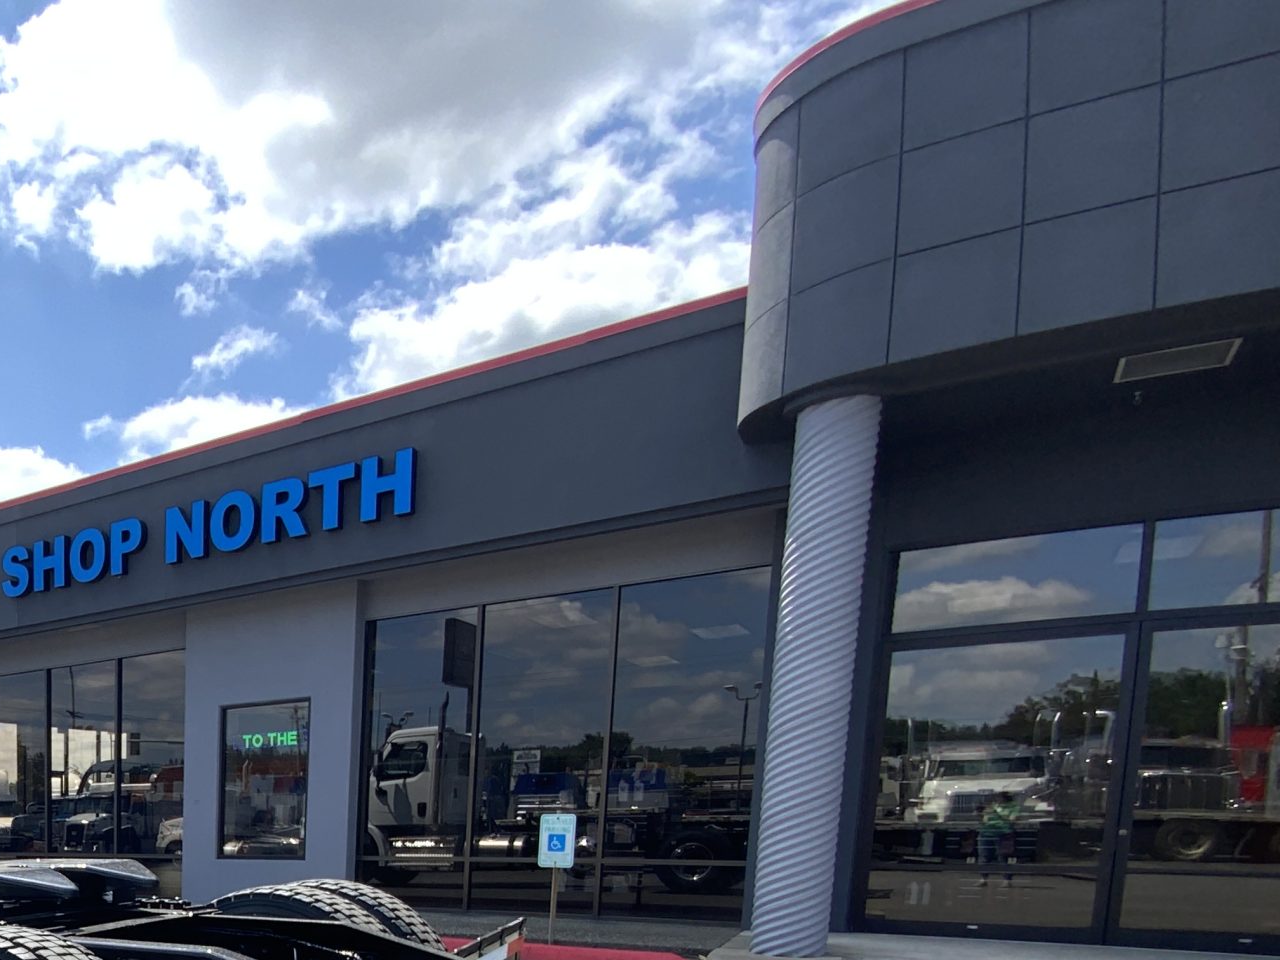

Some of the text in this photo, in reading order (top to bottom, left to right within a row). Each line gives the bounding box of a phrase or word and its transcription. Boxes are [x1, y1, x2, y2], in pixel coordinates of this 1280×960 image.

[2, 518, 143, 597] SHOP
[165, 447, 415, 564] NORTH
[242, 730, 297, 748] TO THE
